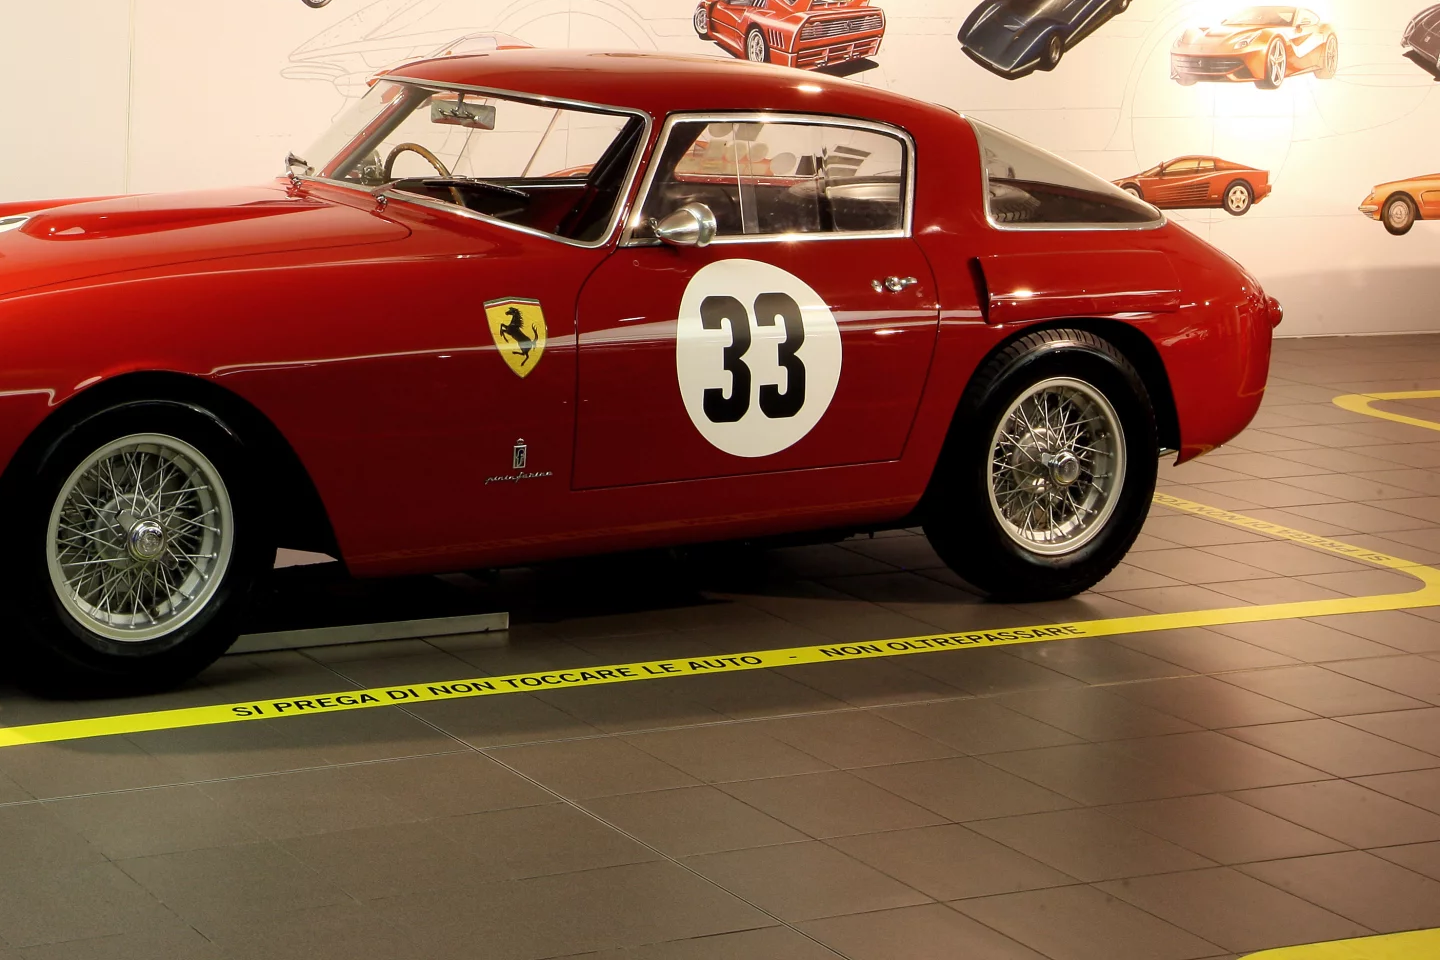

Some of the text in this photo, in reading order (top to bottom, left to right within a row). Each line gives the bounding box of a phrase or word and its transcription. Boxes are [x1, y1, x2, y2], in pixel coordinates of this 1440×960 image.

[699, 292, 807, 424] 33
[232, 705, 264, 717] SI
[272, 693, 380, 713] PREGA
[387, 688, 420, 700] DI
[426, 681, 496, 697] NON
[501, 667, 638, 689] TOCCARE
[641, 663, 682, 675] LE
[688, 655, 763, 671] AUTO
[819, 644, 887, 658] NON
[886, 625, 1086, 651] OLTREPASSARE
